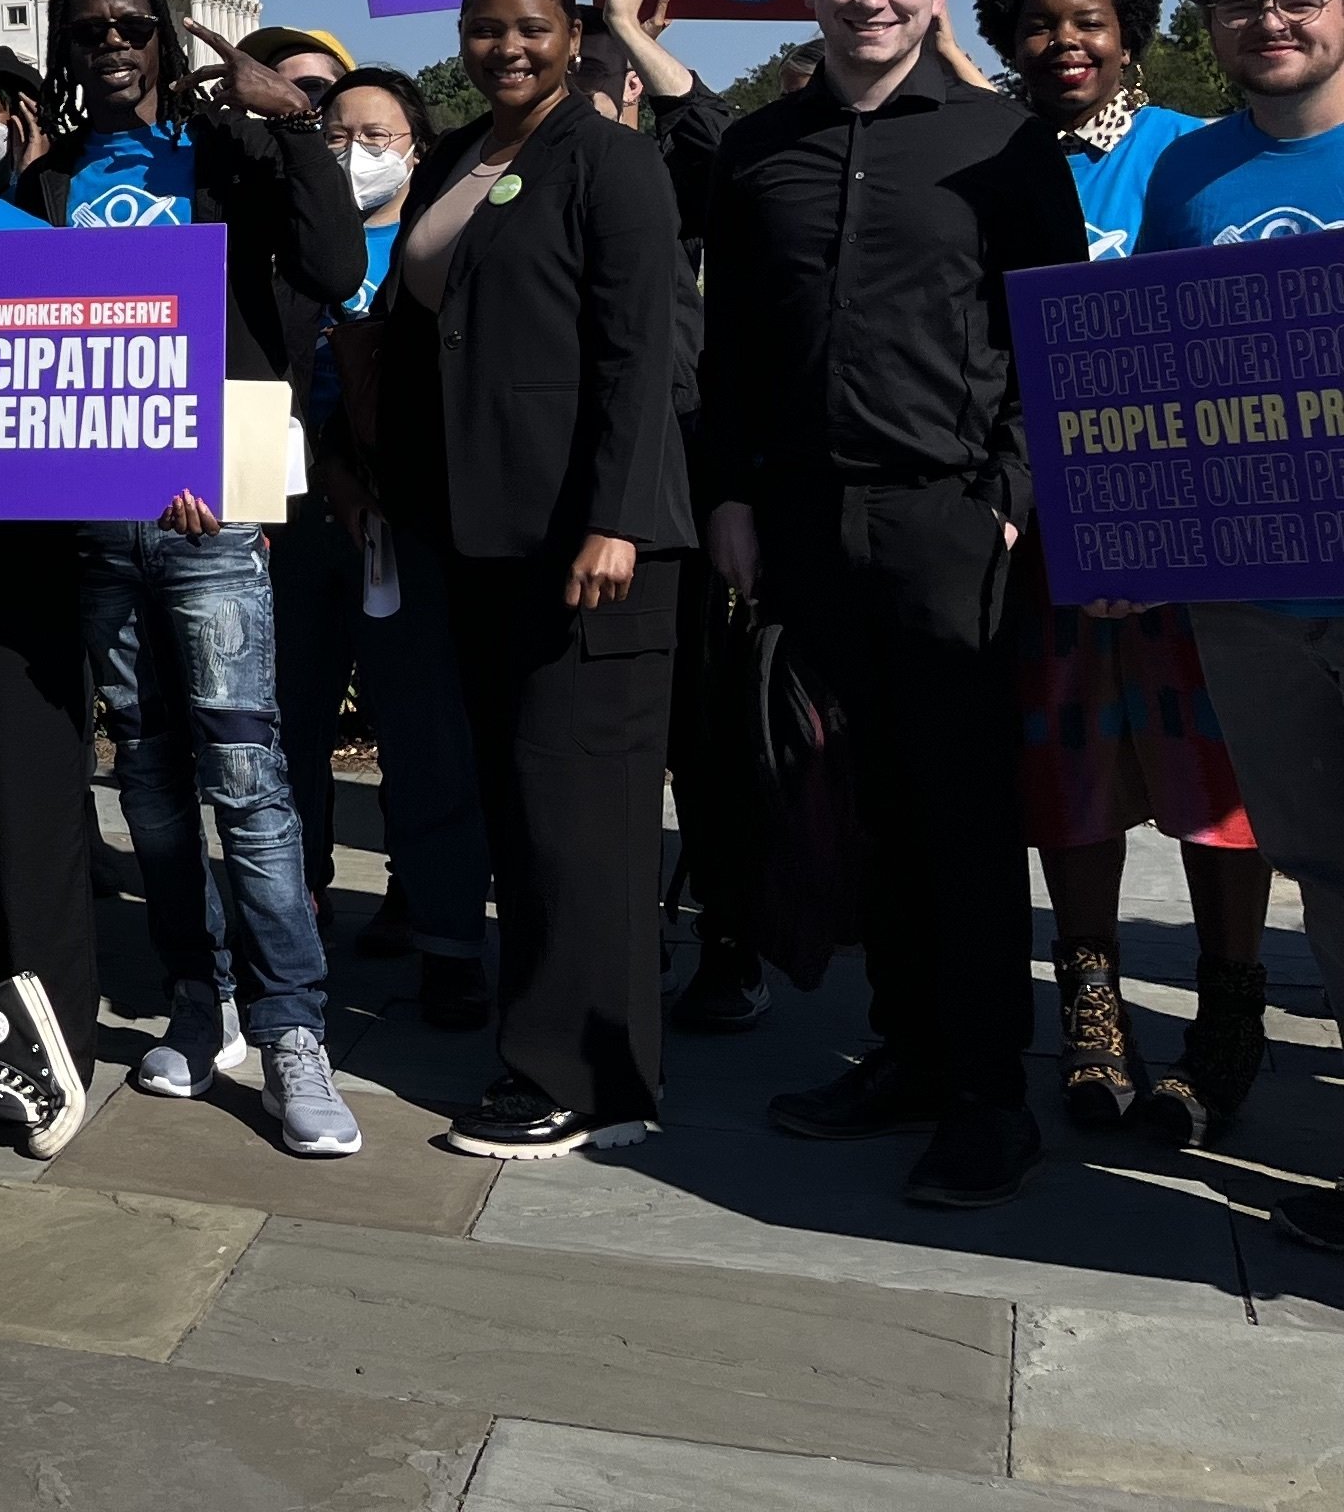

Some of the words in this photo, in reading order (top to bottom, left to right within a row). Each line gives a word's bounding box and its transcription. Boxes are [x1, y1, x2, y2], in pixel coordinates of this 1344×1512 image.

[89, 300, 172, 325] DESERVE
[1040, 285, 1172, 345] PEOPLE
[1176, 273, 1272, 330] OVER
[1048, 343, 1180, 401] PEOPLE
[1184, 332, 1281, 389] OVER
[1287, 324, 1344, 381] PR
[1057, 401, 1188, 456] PEOPLE
[1194, 393, 1289, 447] OVER
[1065, 459, 1198, 514] PEOPLE
[1202, 452, 1300, 506] OVER
[1074, 518, 1208, 571] PEOPLE
[1211, 513, 1310, 567] OVER
